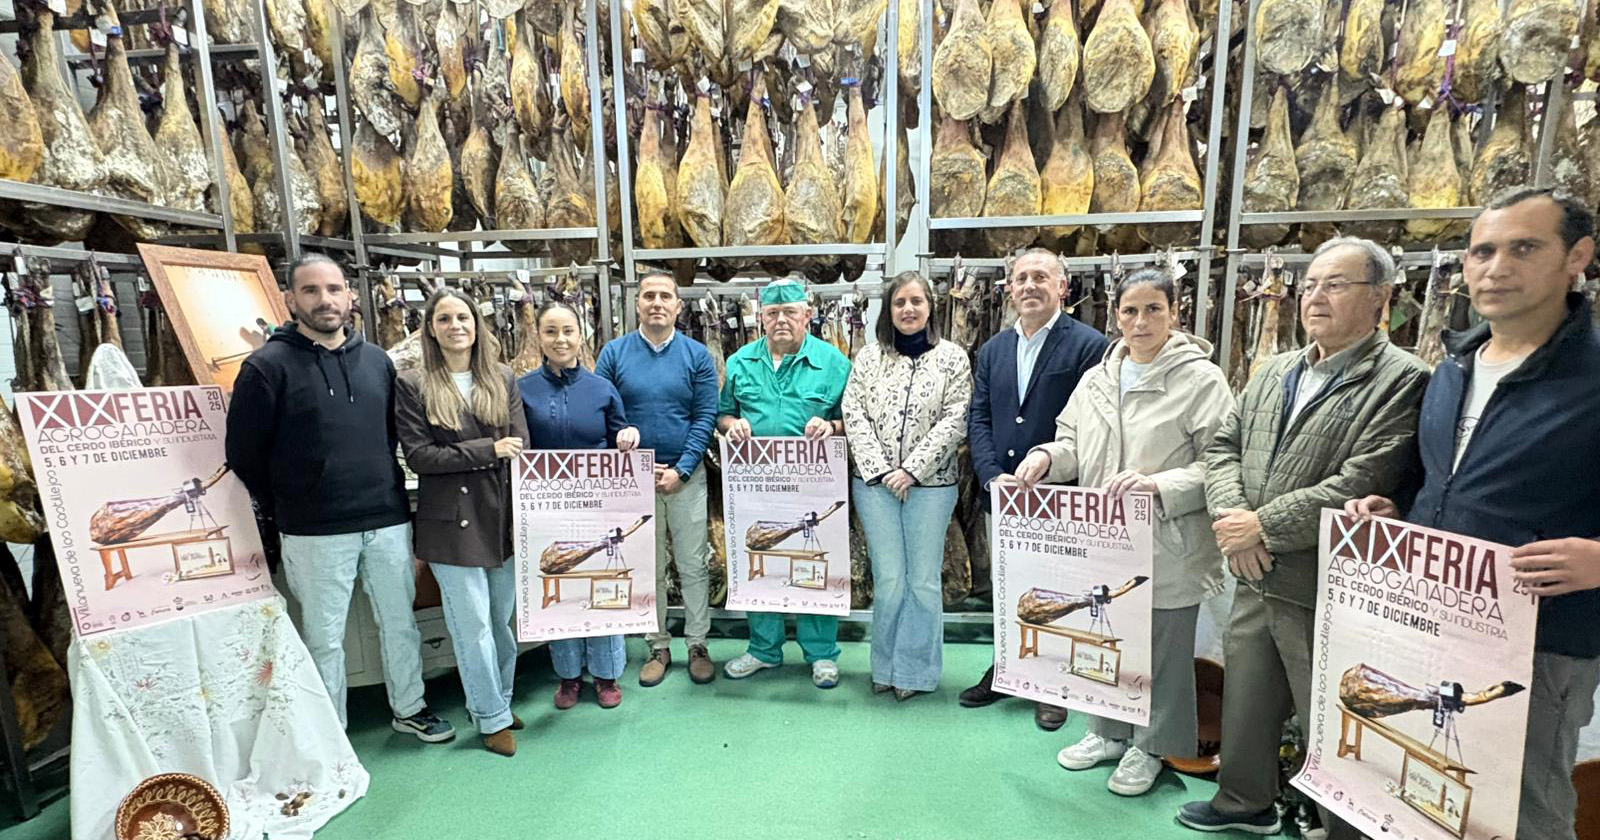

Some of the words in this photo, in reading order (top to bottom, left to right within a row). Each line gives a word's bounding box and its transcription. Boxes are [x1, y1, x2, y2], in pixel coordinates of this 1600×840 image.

[207, 391, 219, 400] 20
[28, 393, 118, 429] XIX
[112, 390, 202, 423] FERIA
[210, 401, 221, 411] 25
[40, 444, 64, 454] DEL
[68, 442, 105, 452] CERDO
[153, 438, 161, 446] Y
[728, 440, 773, 464] XIX
[773, 440, 828, 463] FERIA
[834, 450, 842, 458] 25
[60, 456, 67, 466] 6
[71, 455, 78, 465] Y
[84, 454, 89, 464] 7
[94, 452, 108, 463] DE
[111, 447, 168, 461] DICIEMBRE
[520, 453, 574, 480] XIX
[574, 453, 634, 478] FERIA
[641, 463, 650, 471] 25
[530, 502, 535, 510] 6
[538, 502, 543, 510] Y
[552, 501, 562, 510] DE
[564, 500, 603, 509] DICIEMBRE
[999, 485, 1056, 520] XIX
[1056, 490, 1126, 526] FERIA
[1135, 499, 1146, 509] 20
[1135, 510, 1146, 521] 25
[61, 531, 74, 548] los
[1000, 529, 1014, 538] DEL
[1017, 531, 1043, 540] CERDO
[66, 550, 77, 564] de
[1009, 541, 1014, 549] 6
[1017, 541, 1022, 550] Y
[1025, 542, 1029, 551] 7
[1032, 543, 1041, 553] DE
[1045, 544, 1088, 558] DICIEMBRE
[1330, 514, 1409, 573] XIX
[1407, 530, 1498, 599] FERIA
[521, 576, 528, 586] de
[1328, 575, 1347, 588] DEL
[1351, 580, 1383, 598] CERDO
[1431, 606, 1438, 615] Y
[1340, 592, 1345, 603] 6
[1350, 595, 1355, 607] Y
[1359, 598, 1364, 609] 7
[1367, 601, 1380, 615] DE
[1384, 606, 1440, 637] DICIEMBRE
[999, 618, 1006, 630] de
[1319, 603, 1333, 671] Castillejos
[1318, 675, 1327, 693] los
[1318, 695, 1326, 711] de
[1310, 714, 1324, 770] Villanueva
